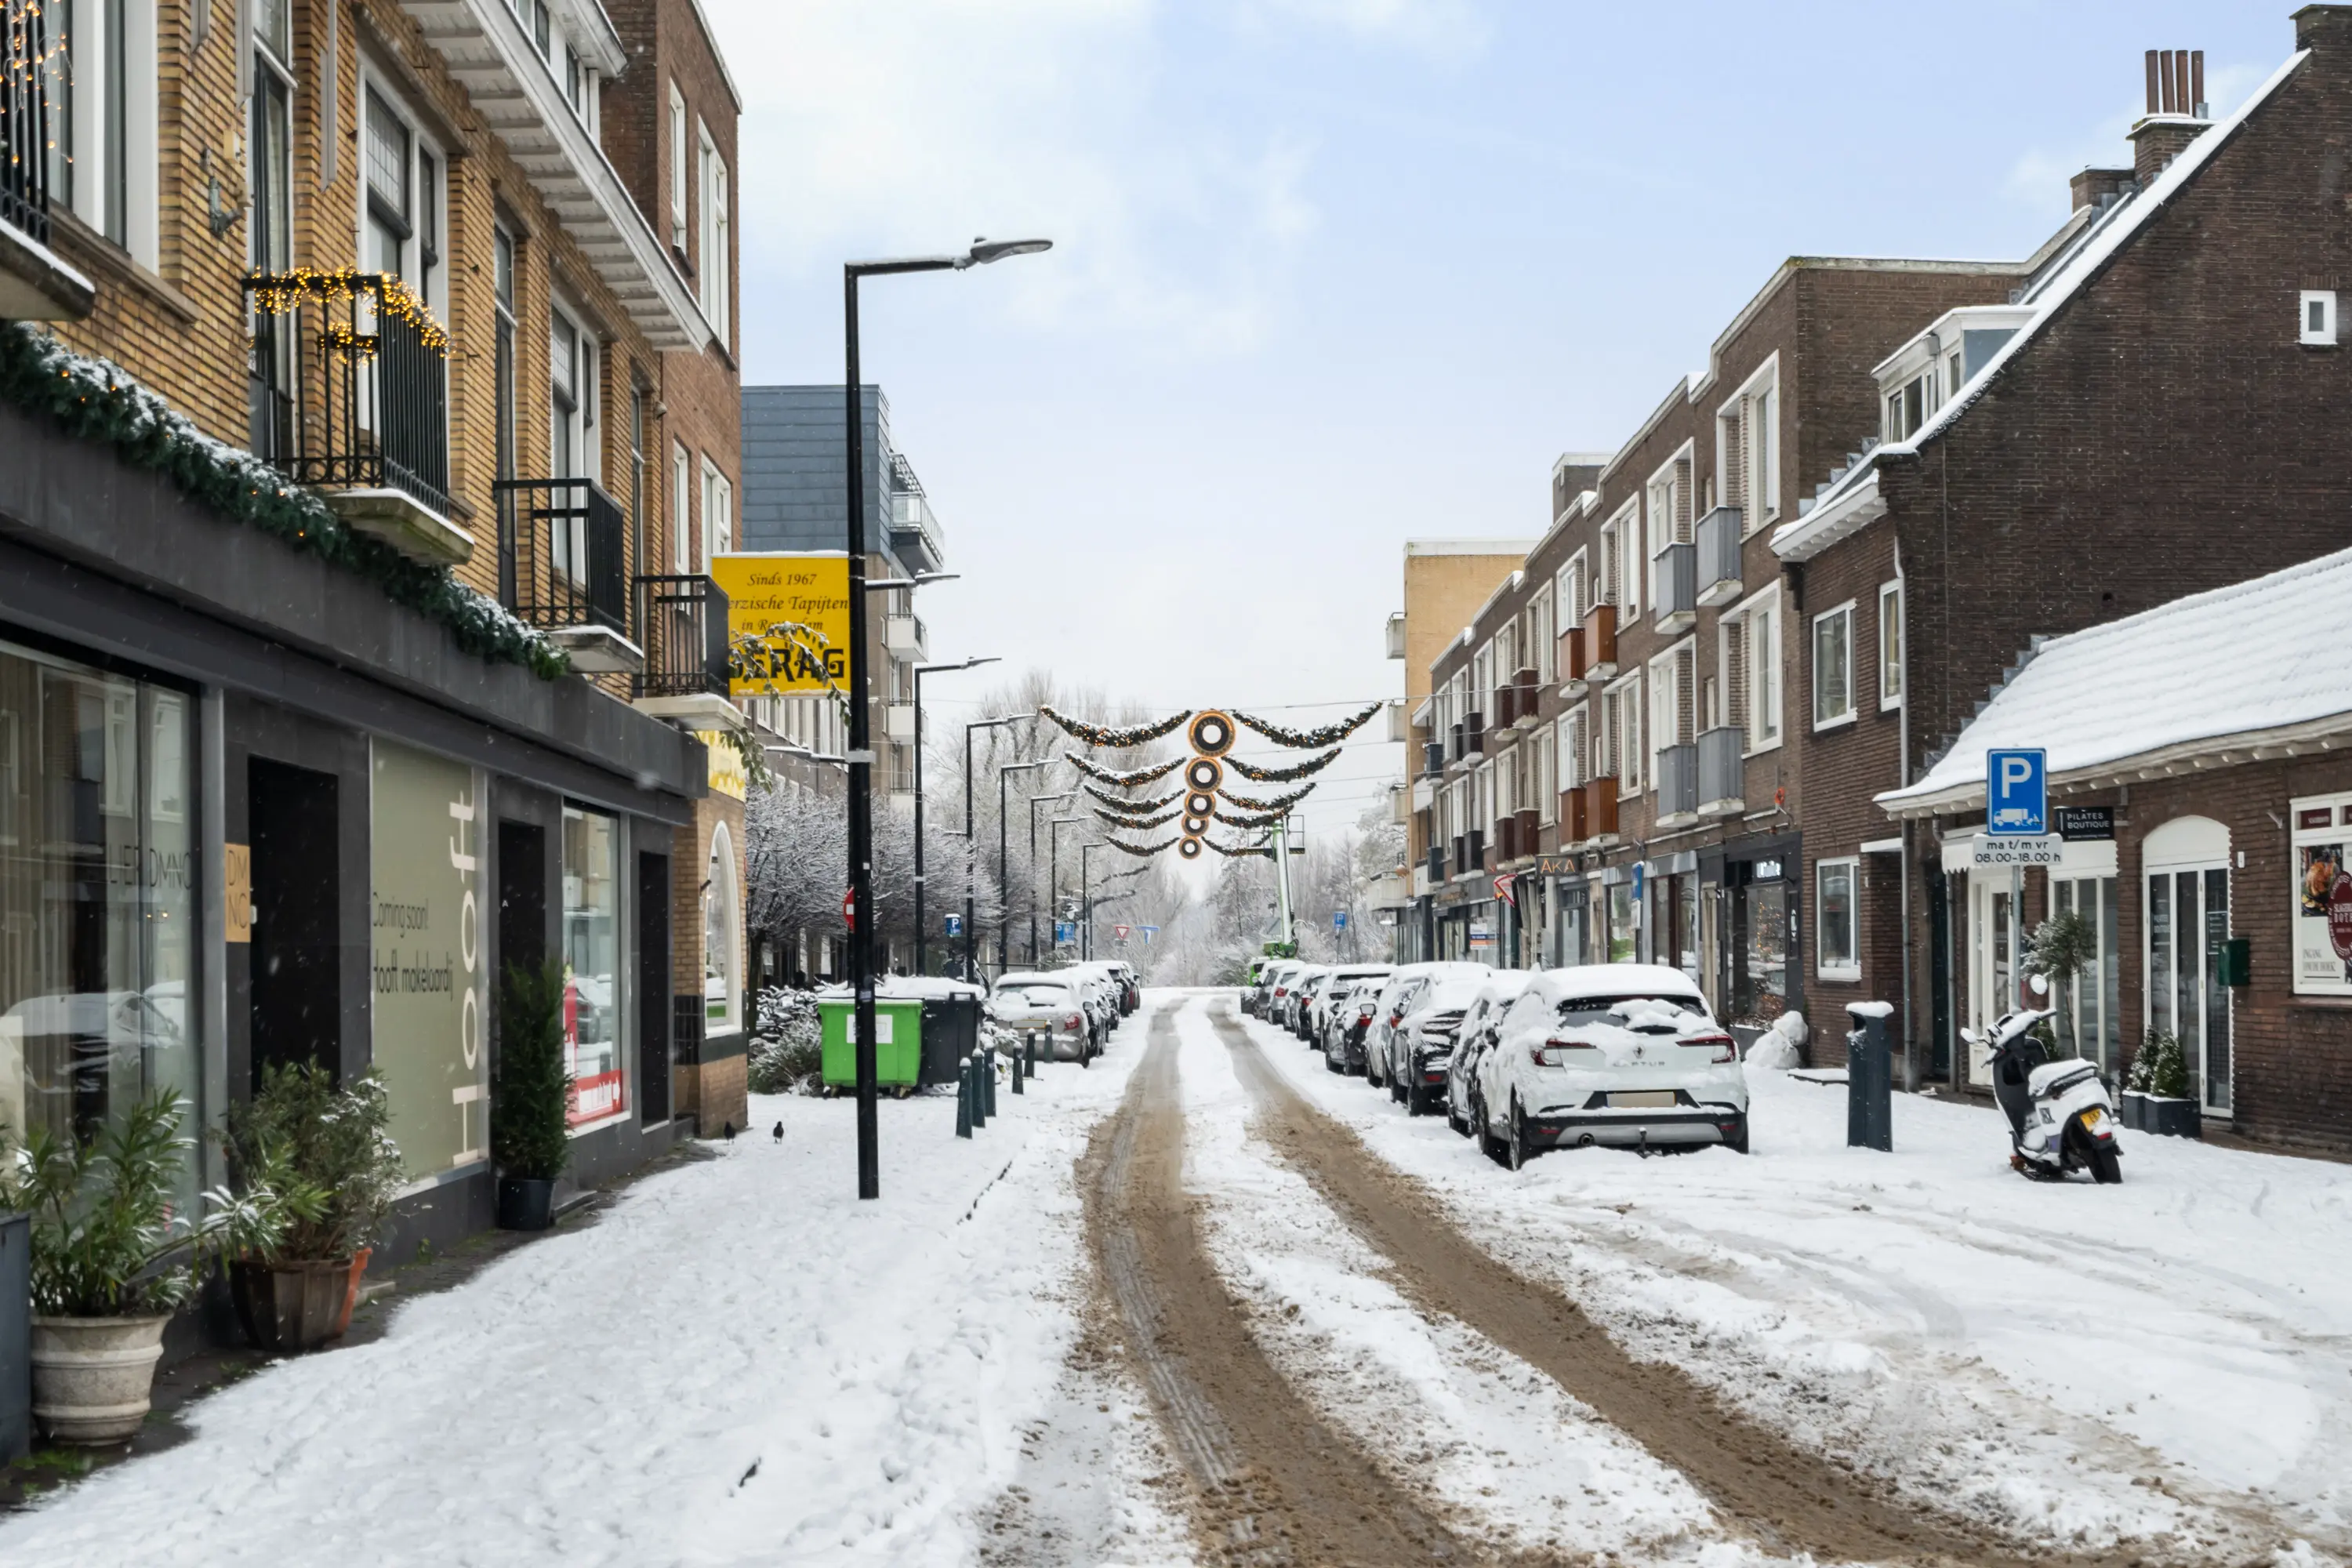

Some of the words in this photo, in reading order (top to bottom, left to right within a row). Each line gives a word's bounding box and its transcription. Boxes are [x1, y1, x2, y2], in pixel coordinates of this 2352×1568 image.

[747, 572, 782, 586] Sinds
[786, 573, 818, 586] 1967
[728, 595, 785, 610] erzische
[788, 596, 848, 615] Tapijten
[742, 618, 753, 630] in
[2001, 757, 2033, 799] P
[2067, 812, 2104, 821] PILATES
[2067, 821, 2111, 830] BOUTIQUE
[2009, 839, 2032, 851] t/m
[2035, 841, 2049, 850] vr
[1975, 852, 2051, 863] 08.00-18.00
[2053, 852, 2061, 862] h
[227, 849, 249, 887] DM
[1540, 858, 1576, 875] AKA
[227, 892, 249, 930] NC
[373, 891, 405, 938] Coming
[952, 918, 959, 928] P
